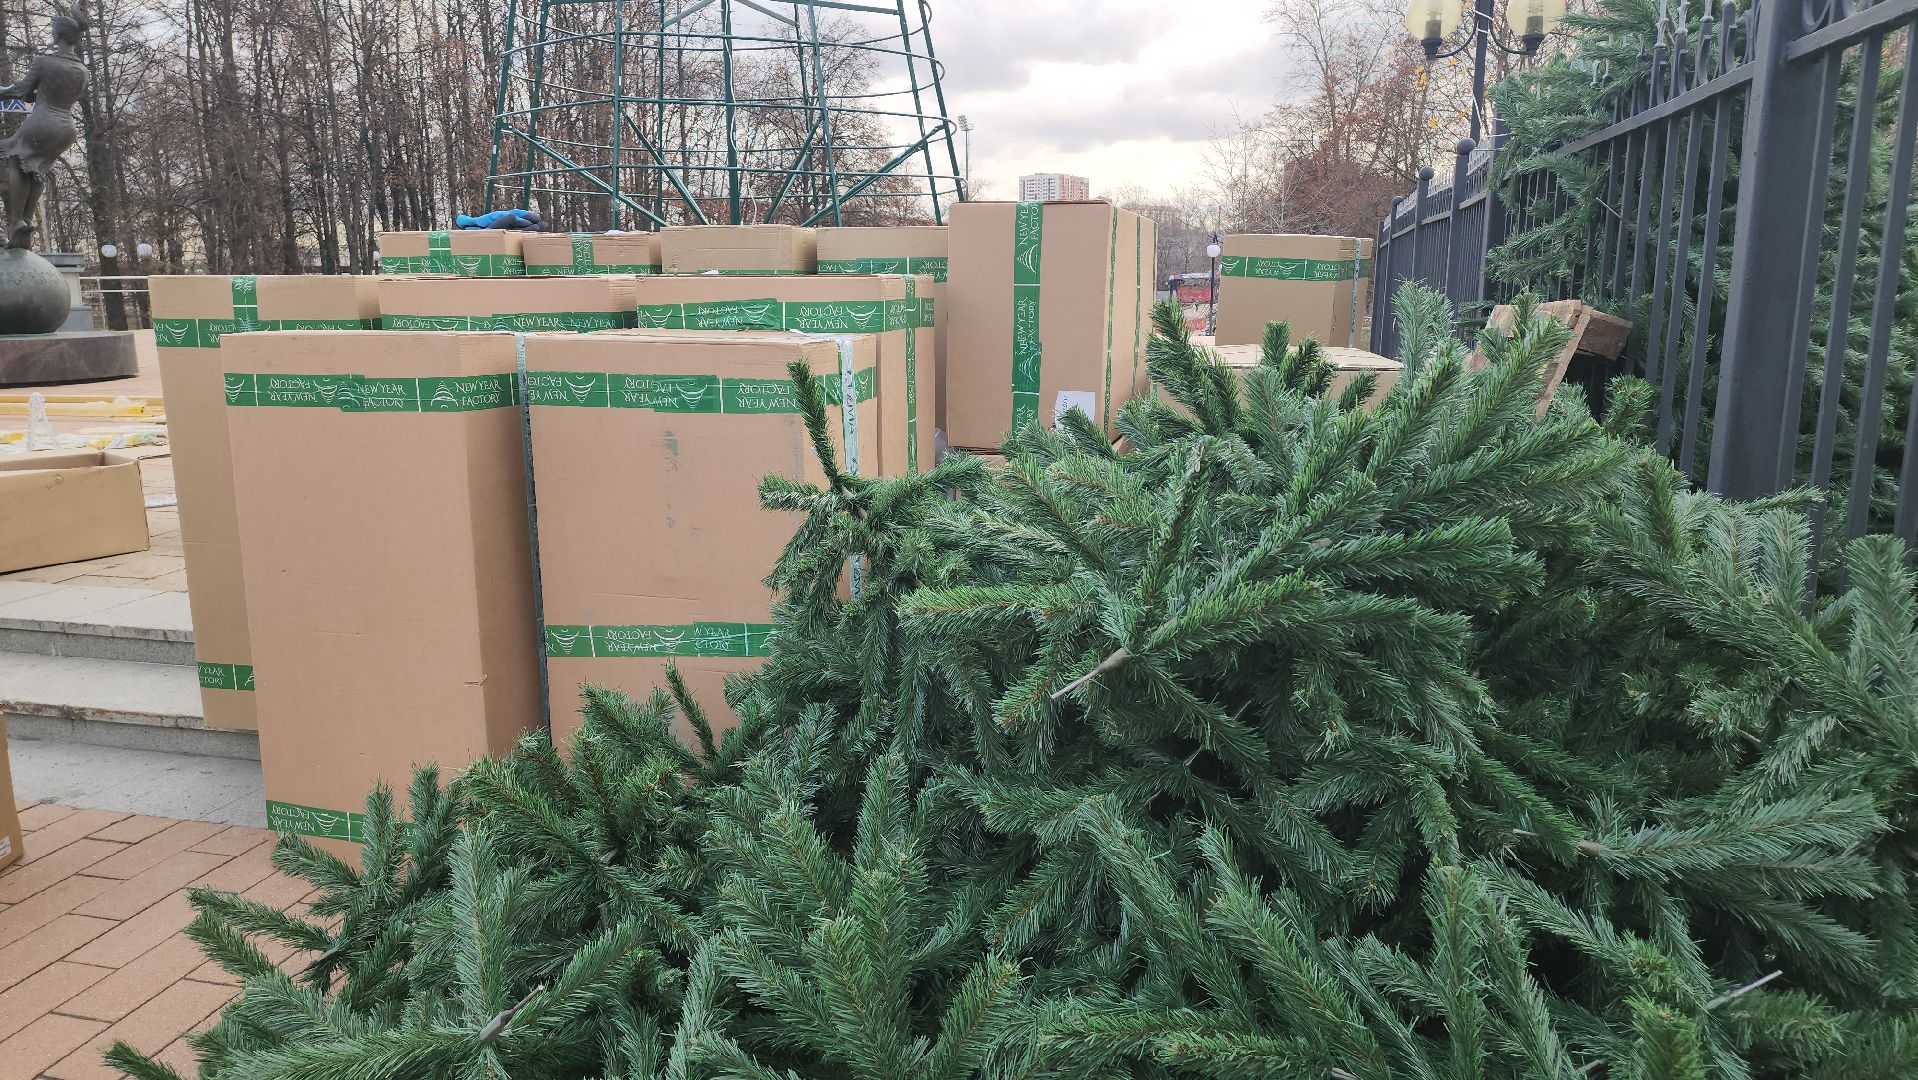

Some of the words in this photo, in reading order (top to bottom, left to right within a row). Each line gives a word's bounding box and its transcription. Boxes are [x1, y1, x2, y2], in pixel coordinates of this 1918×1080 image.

[799, 304, 843, 316] FACTORY
[513, 315, 536, 328] NEW
[537, 317, 565, 329] YEAR
[796, 317, 824, 329] YEAR
[824, 317, 848, 330] NEW
[268, 377, 311, 389] FACTORY
[454, 380, 480, 394] NEW
[479, 378, 504, 392] YEAR
[528, 375, 562, 387] FACTO
[355, 382, 380, 396] NEW
[381, 382, 407, 396] YEAR
[542, 388, 569, 402] NEW
[737, 383, 790, 395] FACTORY
[363, 397, 405, 409] FACTORY
[461, 392, 500, 407] FACTORY
[736, 396, 766, 408] YEAR
[203, 666, 226, 677] YEAR
[271, 805, 310, 819] FACTORY
